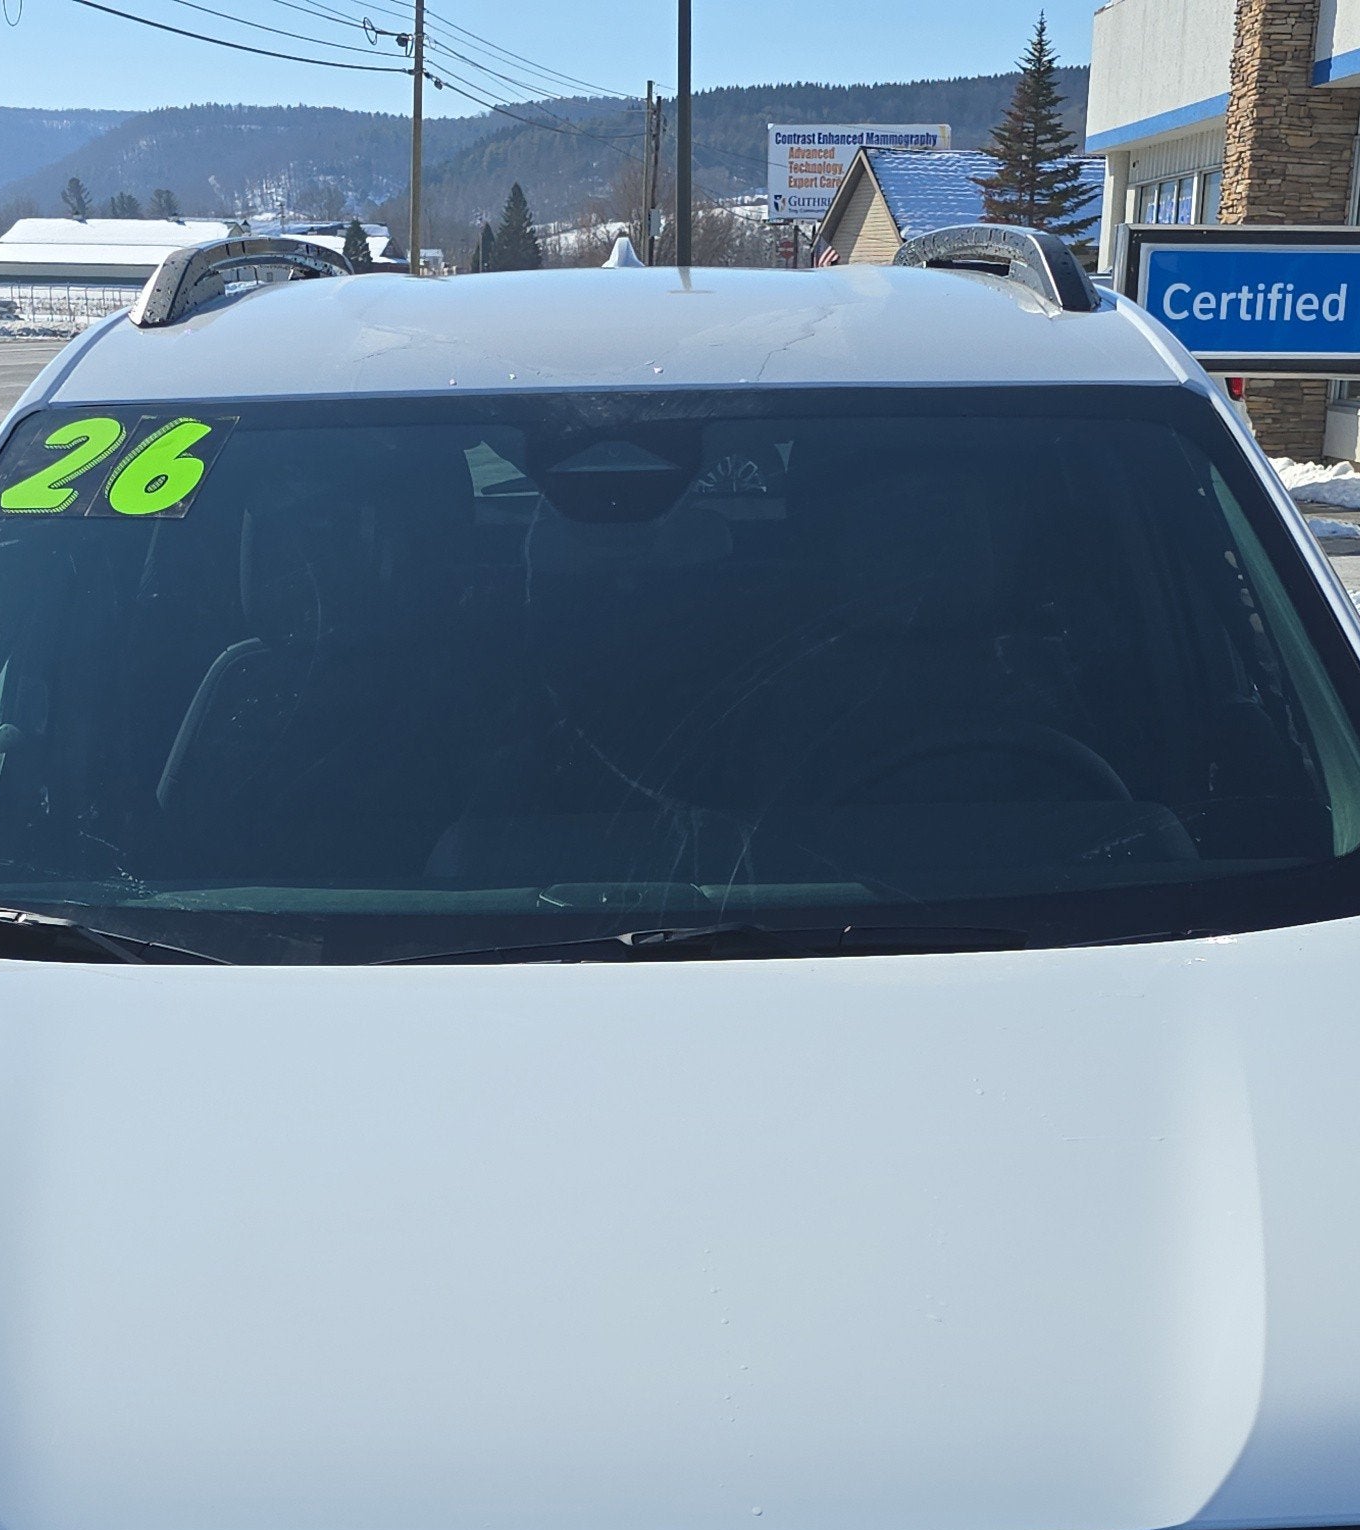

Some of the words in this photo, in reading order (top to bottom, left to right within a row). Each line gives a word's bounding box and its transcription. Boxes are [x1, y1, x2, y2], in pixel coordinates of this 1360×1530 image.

[775, 132, 816, 145] Contrast
[817, 132, 864, 145] Enhanced
[866, 132, 938, 147] Mammography
[788, 147, 835, 159] Advanced
[788, 175, 818, 189] Expert
[1162, 282, 1348, 321] Certified
[0, 417, 213, 516] 26
